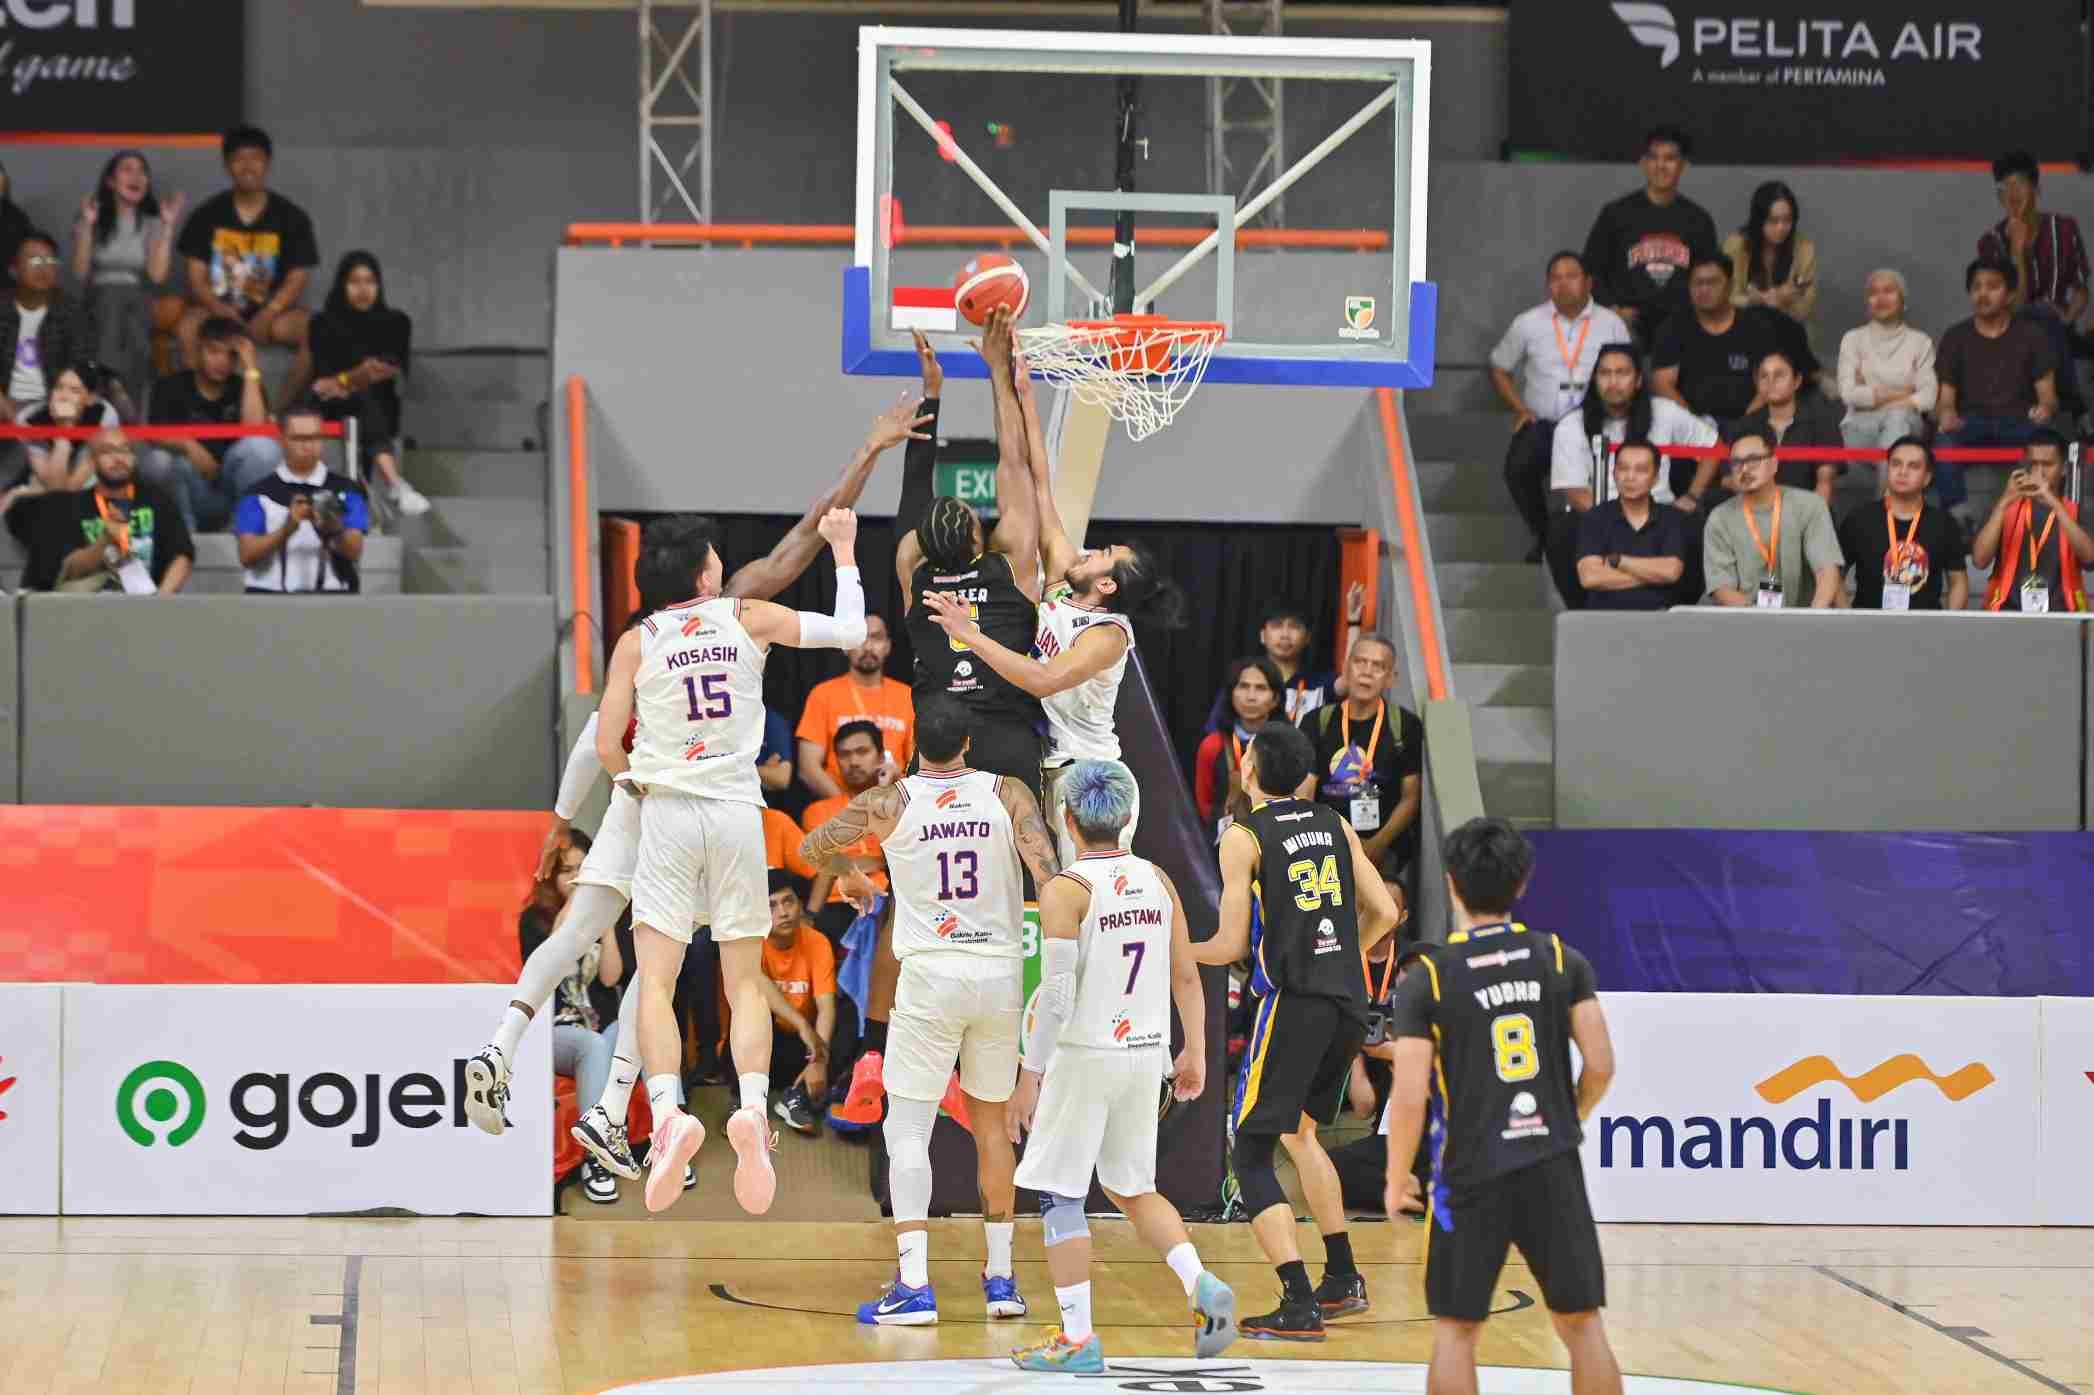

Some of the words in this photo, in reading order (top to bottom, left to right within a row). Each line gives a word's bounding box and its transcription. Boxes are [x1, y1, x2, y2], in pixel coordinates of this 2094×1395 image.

[1693, 18, 1880, 59] PELITA
[1890, 22, 1983, 61] AIR
[12, 54, 136, 95] game
[1783, 65, 1887, 87] PERTAMINA
[956, 468, 997, 500] EXI
[666, 646, 738, 671] KOSASIH
[682, 673, 732, 722] 15
[918, 821, 990, 842] JAWATO
[936, 850, 978, 901] 13
[1287, 854, 1343, 912] 34
[1099, 908, 1162, 933] PRASTAWA
[1122, 940, 1146, 996] 7
[1490, 1012, 1540, 1083] 8
[1599, 1097, 1909, 1170] mandiri
